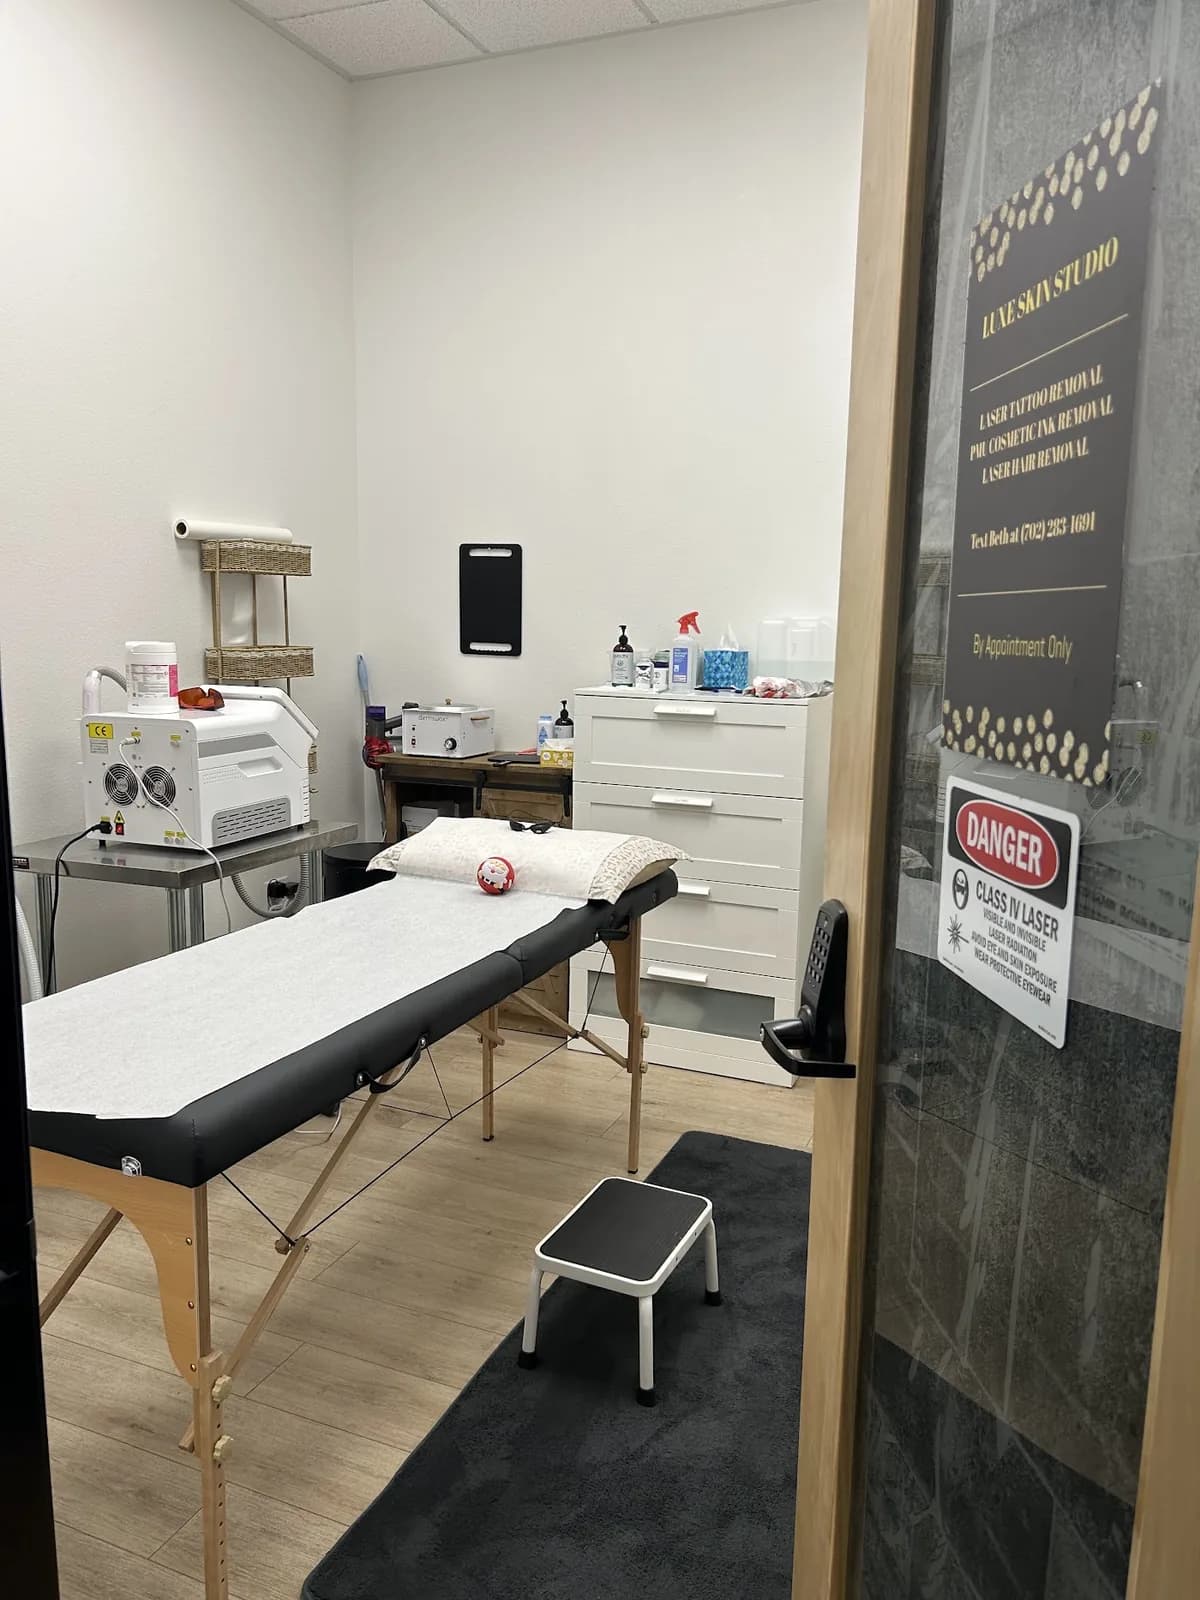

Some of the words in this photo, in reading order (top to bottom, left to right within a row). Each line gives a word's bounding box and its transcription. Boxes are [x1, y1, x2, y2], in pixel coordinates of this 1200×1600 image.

[982, 299, 1015, 340] LUXE
[1016, 276, 1051, 319] SKIN
[1053, 236, 1119, 298] STUDIO
[979, 404, 1010, 431] LASER
[1010, 387, 1048, 419] TATTOO
[1048, 364, 1103, 403] REMOVAL
[988, 422, 1037, 455] COSMETIC
[1037, 416, 1057, 438] INK
[1057, 394, 1114, 431] REMOVAL
[982, 461, 1011, 485] LASER
[1011, 452, 1037, 476] HAIR
[1037, 436, 1089, 469] REMOVAL
[970, 532, 989, 550] Text
[989, 526, 1010, 547] Beth
[1010, 527, 1019, 544] at
[1020, 519, 1046, 545] (702)
[973, 633, 985, 660] By
[985, 634, 1046, 661] Appointment
[1048, 634, 1073, 665] Only
[95, 726, 107, 736] CE
[967, 811, 1043, 878] DANGER
[976, 880, 1007, 914] CLASS
[1009, 895, 1021, 921] IV
[1022, 907, 1059, 942] LASER
[983, 908, 1004, 928] VISIBLE
[1004, 920, 1016, 935] AND
[1016, 926, 1047, 953] INVISIBLE
[972, 930, 987, 947] AVOID
[987, 939, 997, 954] EYE
[997, 945, 1009, 962] AND
[1009, 953, 1024, 971] SKIN
[1024, 962, 1058, 994] EXPOSURE
[988, 927, 1006, 945] LASER
[1006, 937, 1037, 963] RADIATION
[974, 947, 990, 965] WEAR
[989, 957, 1022, 988] PROTECTIVE
[1022, 978, 1051, 1007] EYEWEAR
